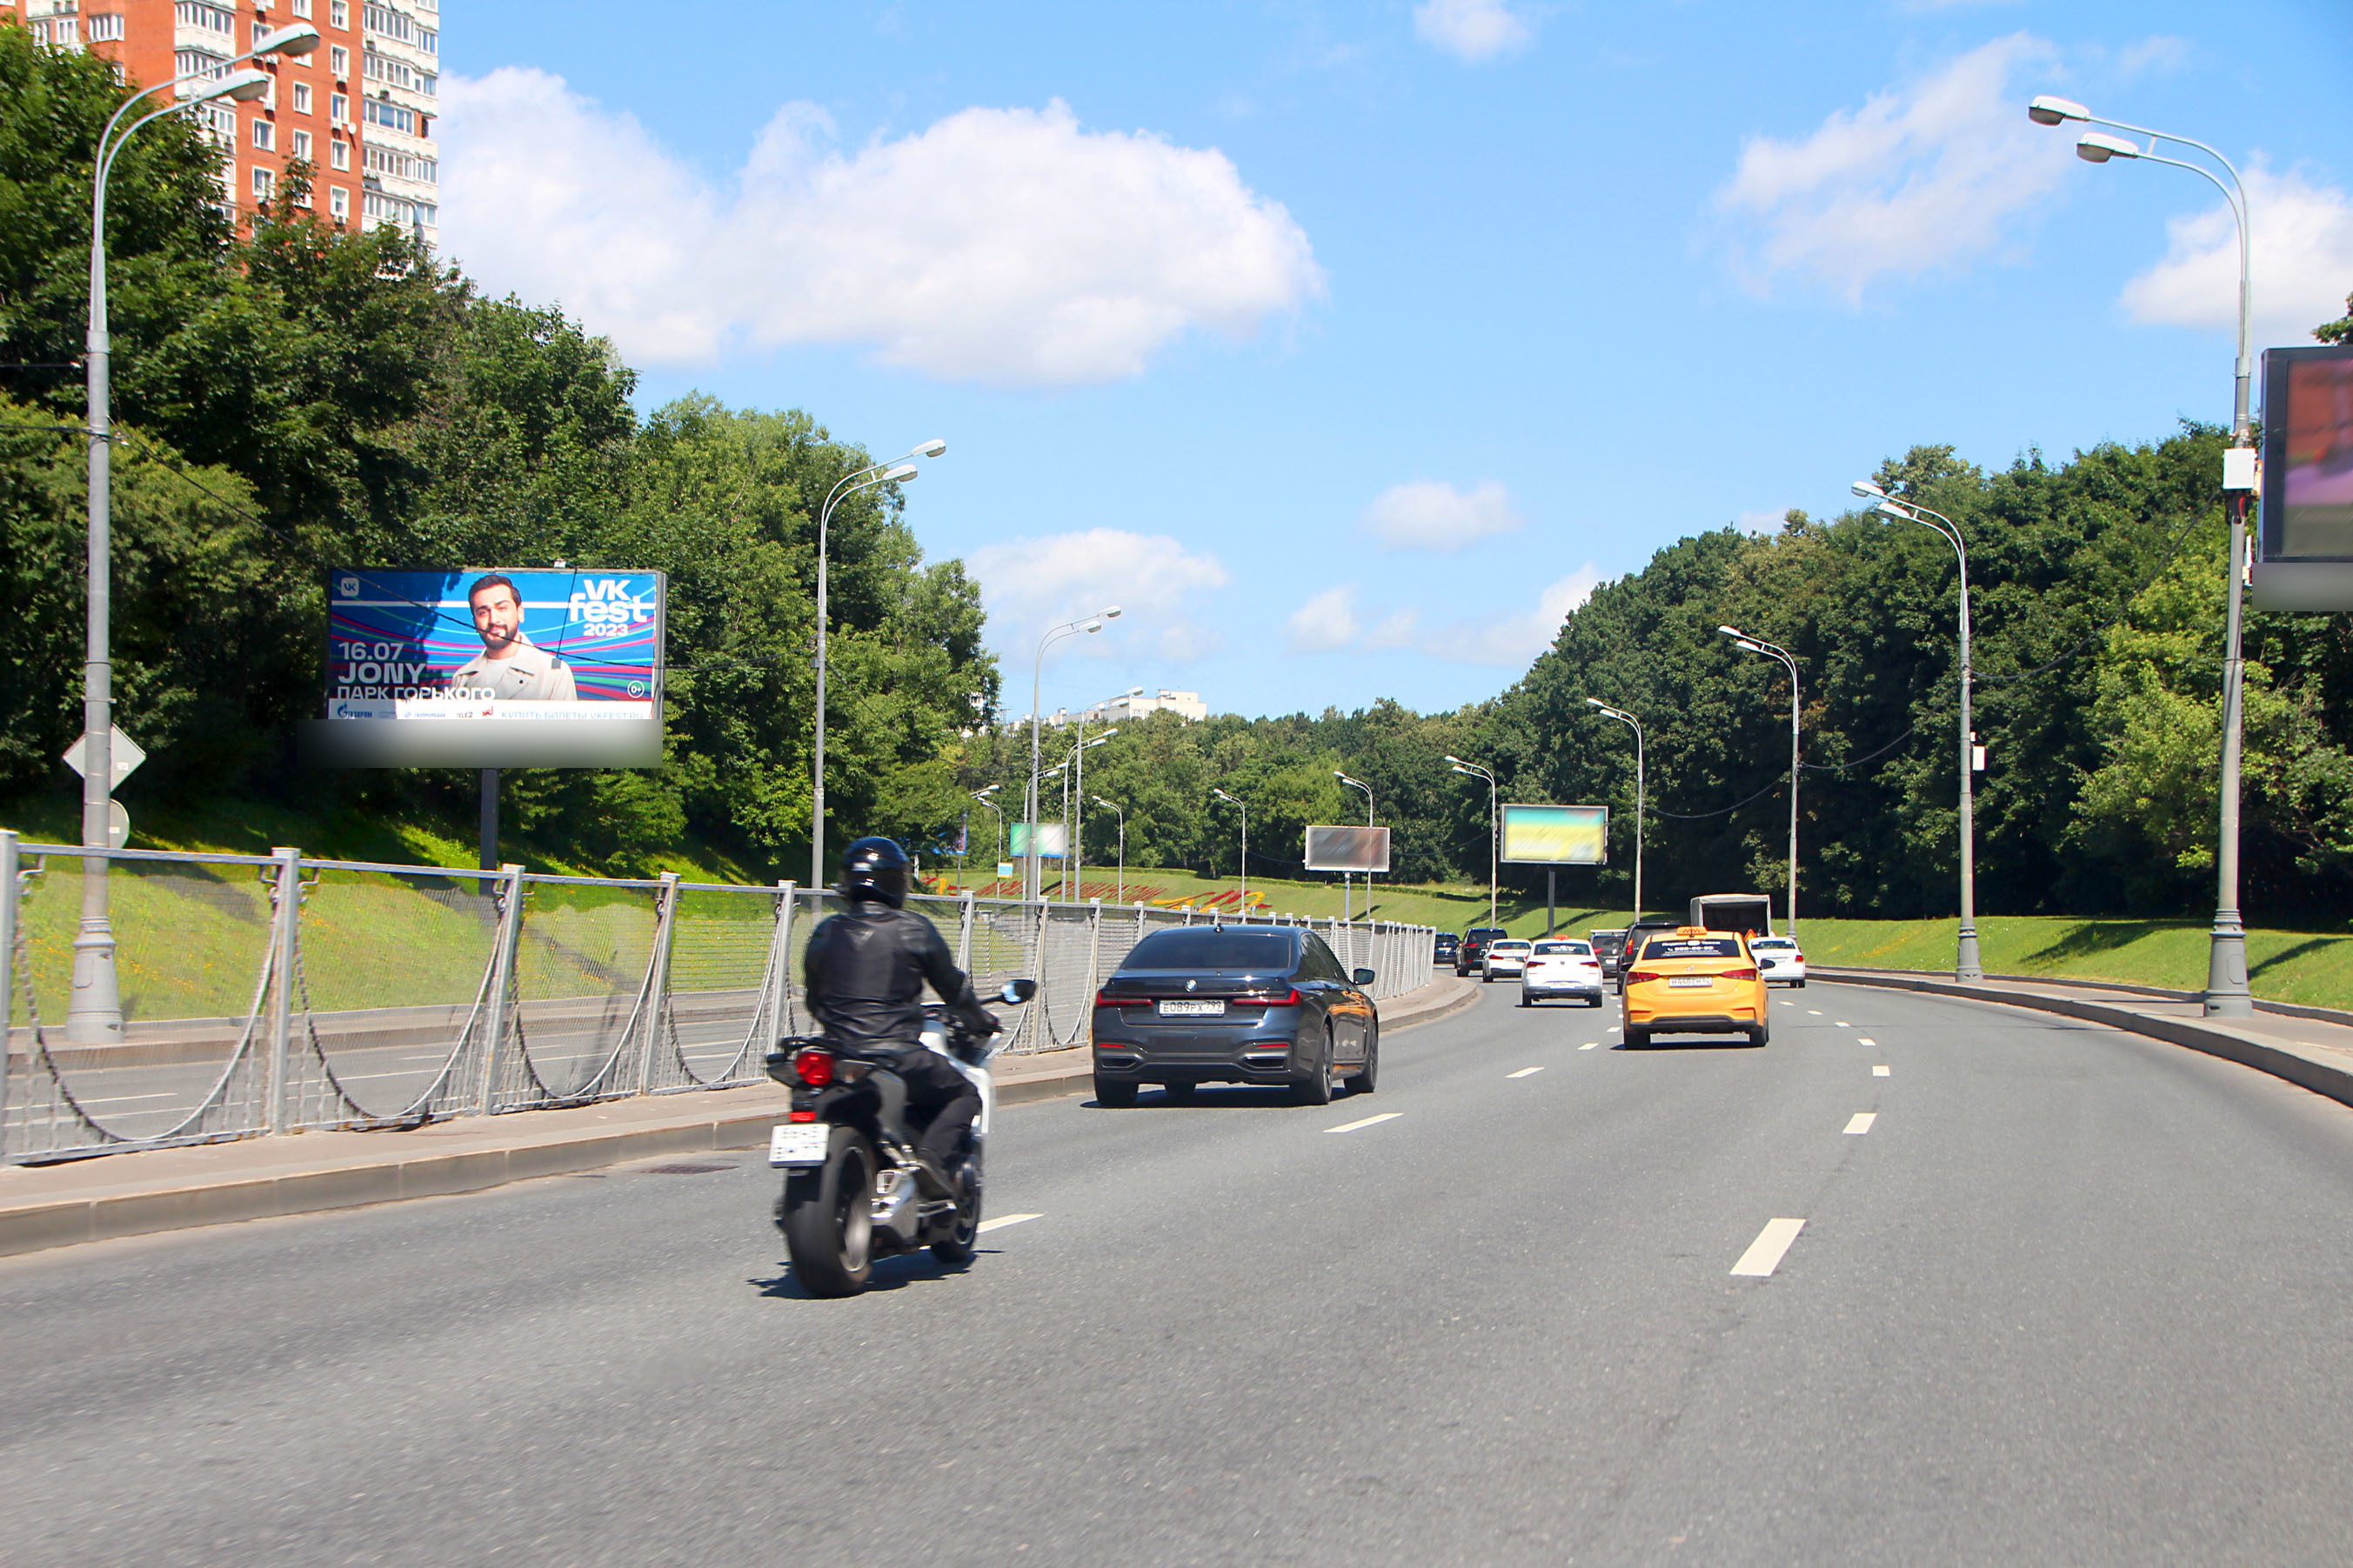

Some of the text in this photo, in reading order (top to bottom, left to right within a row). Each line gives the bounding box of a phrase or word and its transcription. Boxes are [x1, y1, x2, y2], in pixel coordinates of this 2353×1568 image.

[344, 584, 357, 592] VK
[583, 579, 631, 600] VK
[570, 592, 647, 623] fest
[583, 623, 629, 637] 2023
[338, 642, 404, 661] 16.07
[338, 662, 426, 684] JONY
[338, 687, 496, 700] ПАРК ГОРЬКОГО
